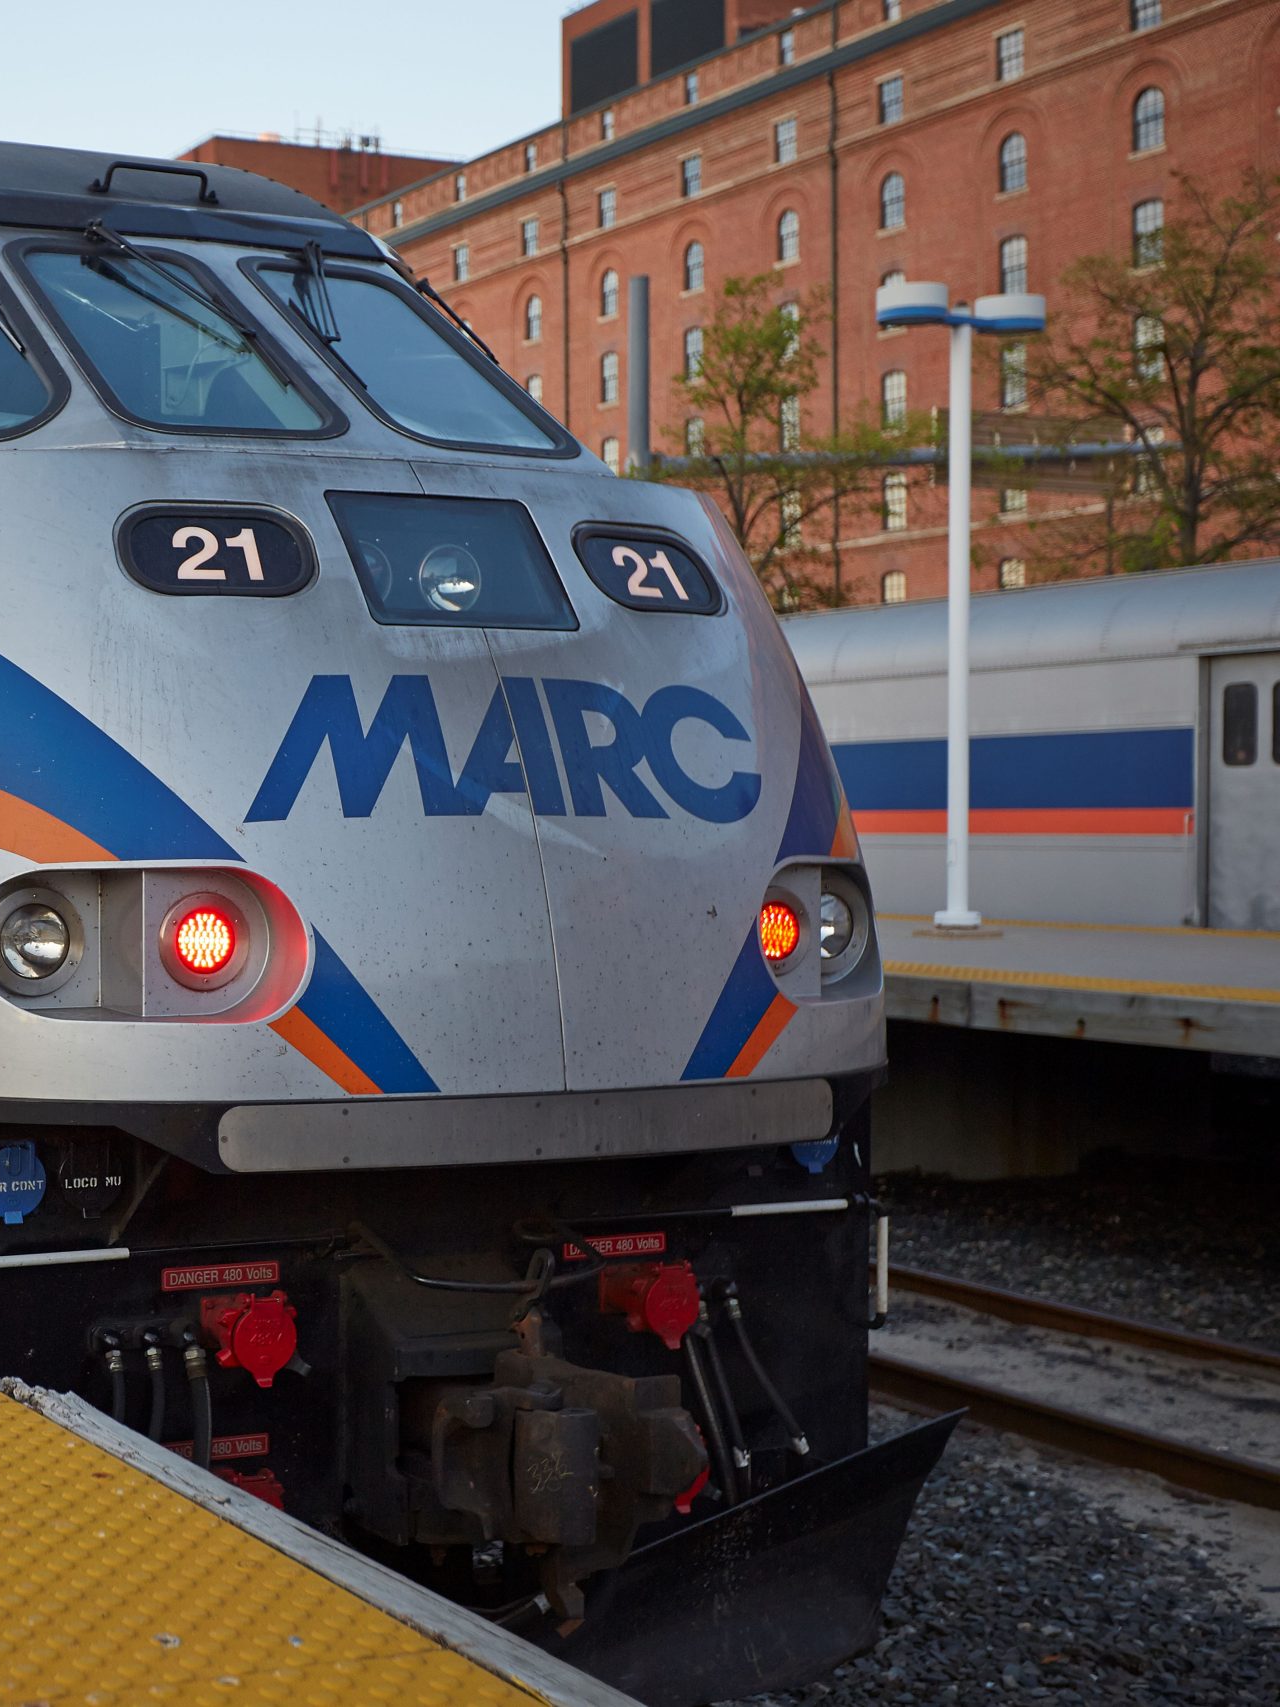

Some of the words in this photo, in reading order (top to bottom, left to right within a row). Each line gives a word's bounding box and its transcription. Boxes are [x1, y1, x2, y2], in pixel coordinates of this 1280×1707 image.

[171, 526, 265, 581] 21
[611, 545, 690, 601] 21
[243, 675, 762, 824] MARC
[11, 1180, 44, 1191] CONT
[65, 1177, 97, 1189] LOCO
[105, 1176, 121, 1187] MU
[570, 1240, 613, 1256] DGER
[616, 1239, 634, 1251] 480
[636, 1238, 660, 1249] Volts
[169, 1271, 219, 1286] DANGER
[223, 1268, 242, 1282] 480
[246, 1267, 273, 1280] Volts
[212, 1442, 232, 1455] 480
[236, 1439, 262, 1453] Volts
